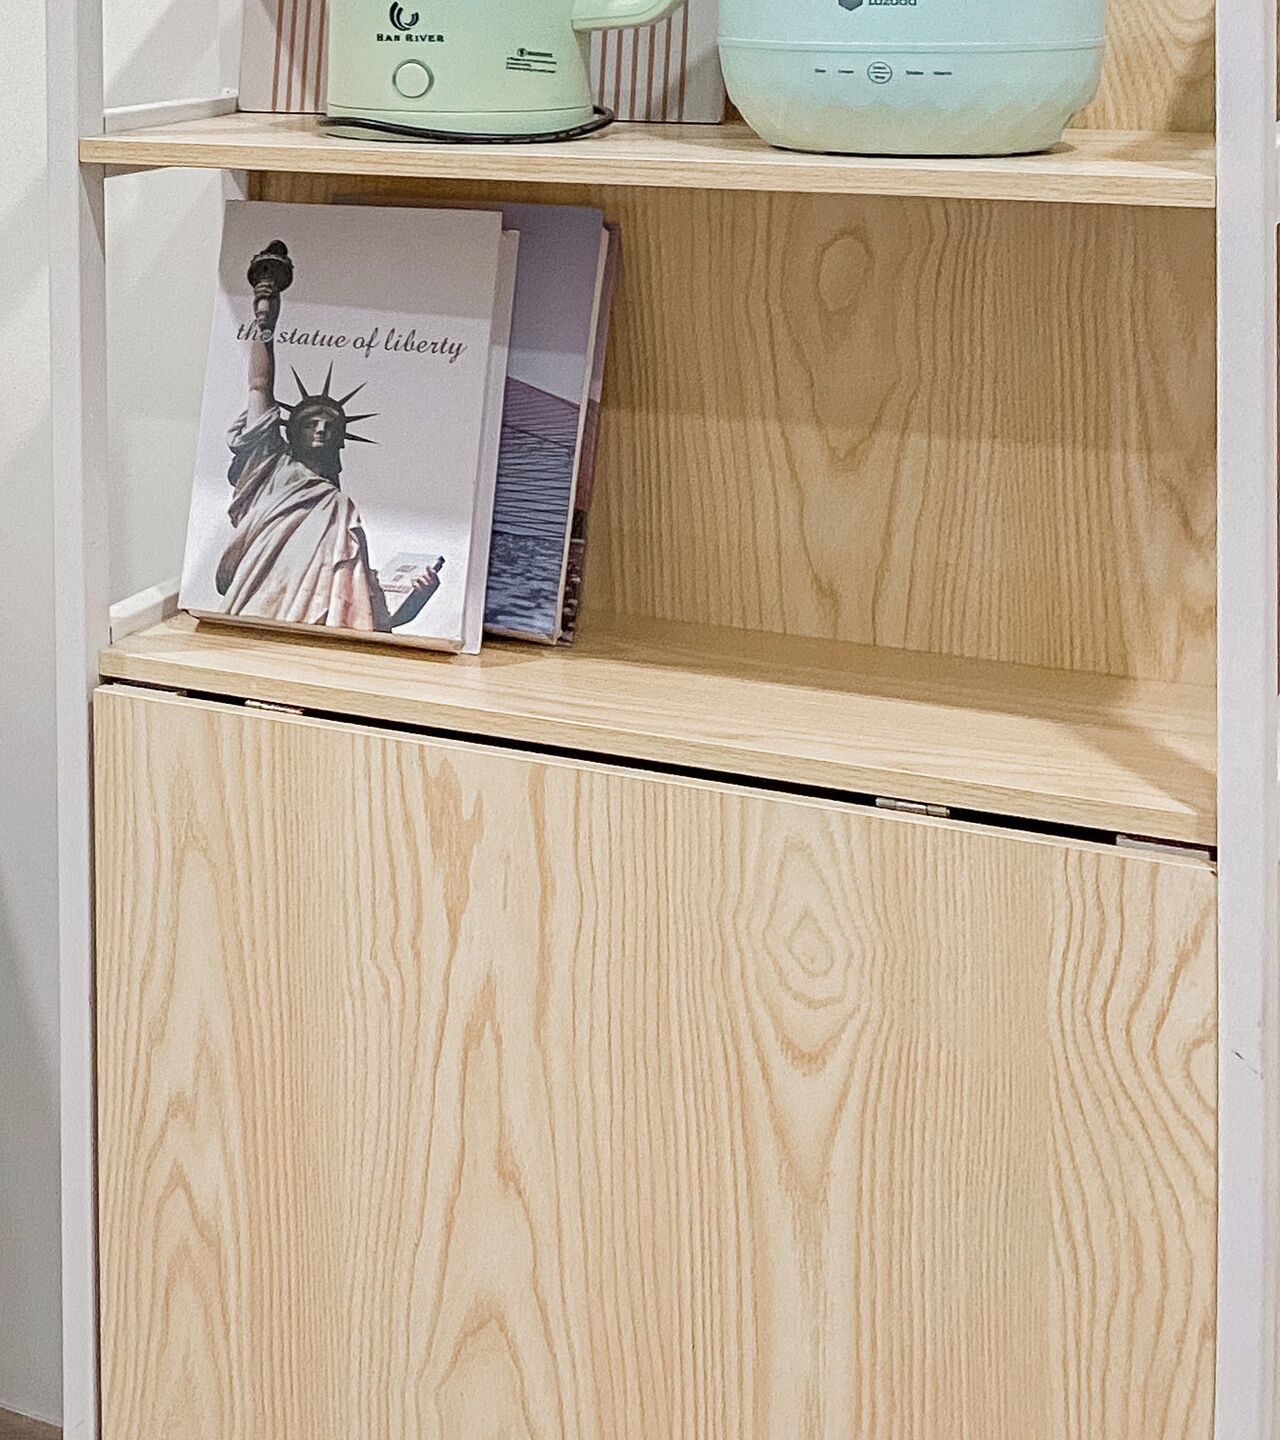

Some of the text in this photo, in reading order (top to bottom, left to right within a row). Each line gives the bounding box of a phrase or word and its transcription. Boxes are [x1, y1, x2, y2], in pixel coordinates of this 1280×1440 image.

[236, 320, 468, 364] the statue of liberty
